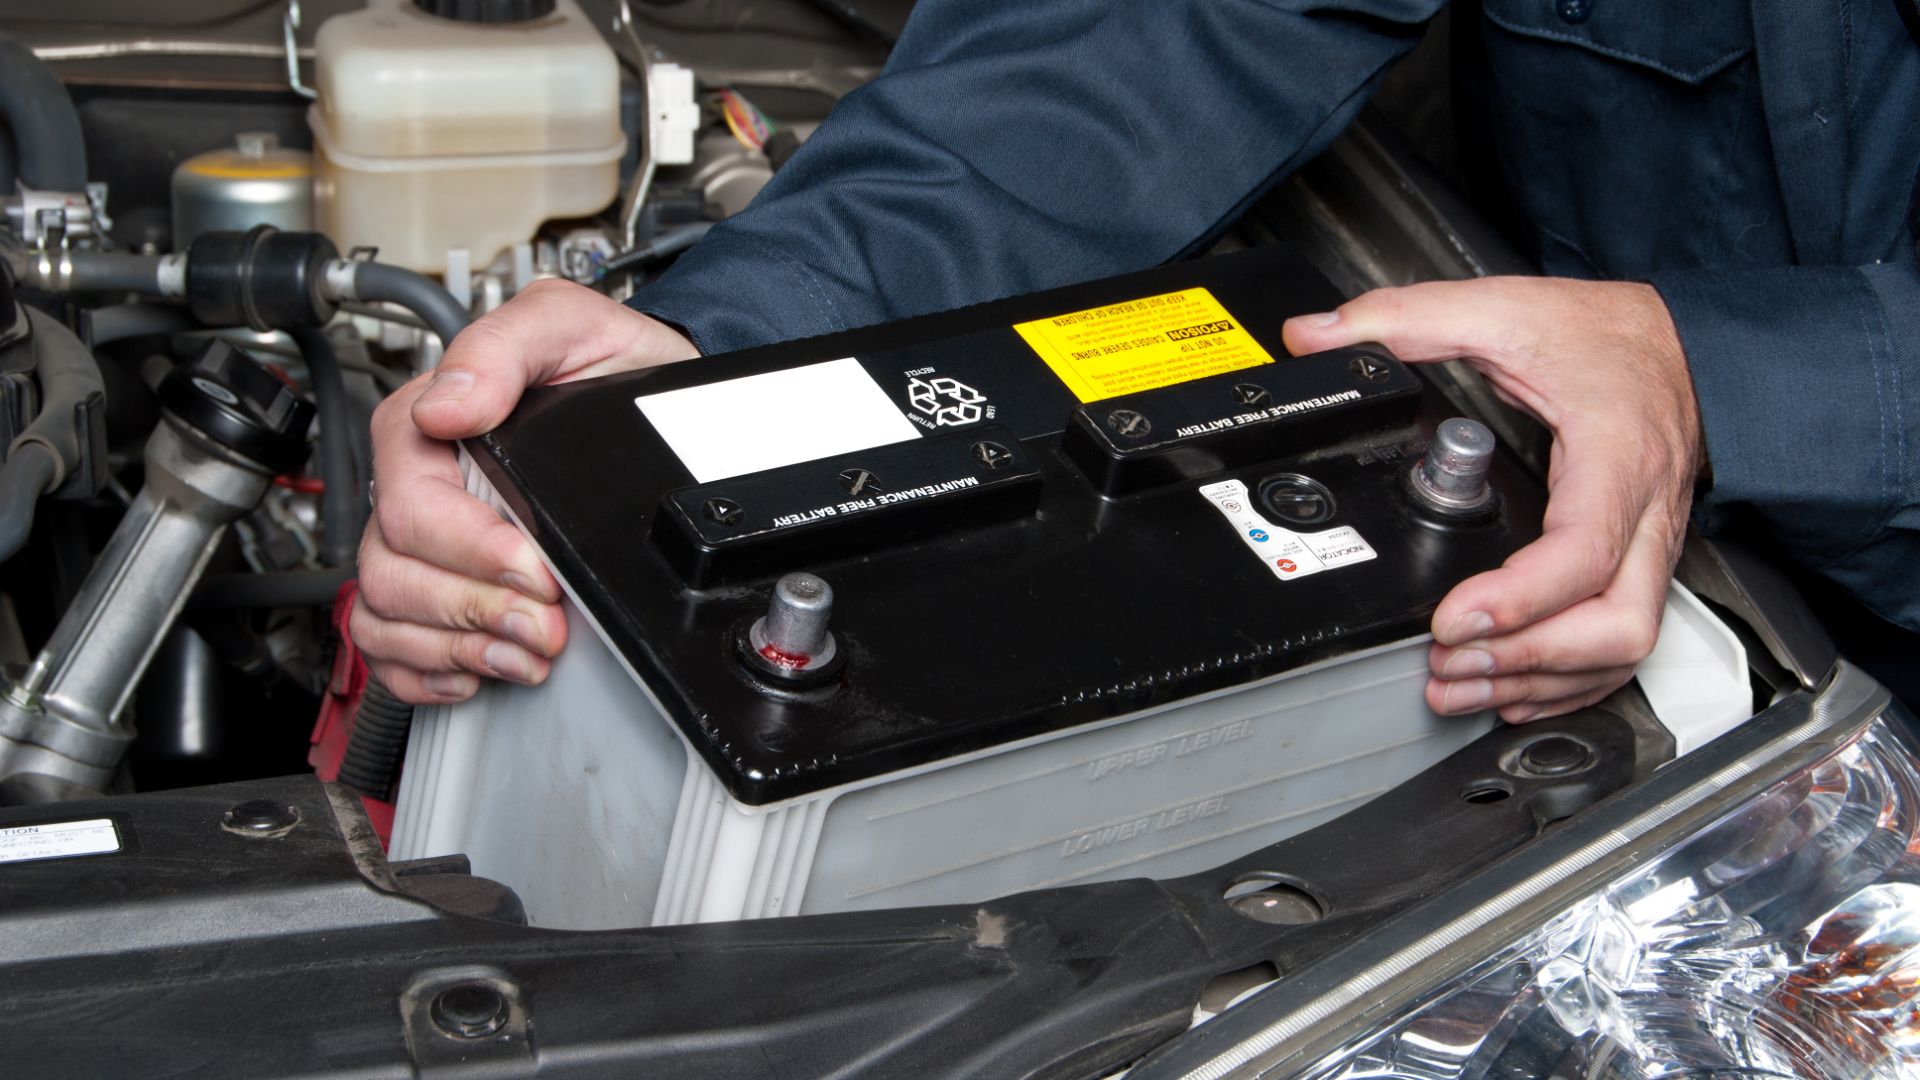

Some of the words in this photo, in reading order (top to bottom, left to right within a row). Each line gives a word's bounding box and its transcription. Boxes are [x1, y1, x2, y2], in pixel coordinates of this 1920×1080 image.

[1145, 297, 1166, 307] OUT
[1163, 293, 1187, 303] KEEP
[1105, 303, 1135, 315] REACH
[1132, 301, 1148, 310] OF
[1051, 312, 1095, 327] CHILDREN
[1092, 309, 1108, 318] OF
[1167, 322, 1220, 340] POISON
[1099, 341, 1134, 354] SEVERE
[1129, 334, 1167, 348] CAUSES
[1193, 339, 1214, 349] NOT
[1210, 336, 1227, 345] DO
[1069, 347, 1102, 361] BURNS
[1176, 343, 1195, 353] TIP
[904, 366, 935, 377] RECYCLE
[1268, 389, 1361, 417] MAINTENANCE
[986, 405, 995, 419] LEAD
[1233, 409, 1268, 425] FREE
[907, 412, 936, 429] RETURN
[1175, 418, 1232, 437] BATTERY
[876, 476, 978, 504] MAINTENANCE
[837, 497, 874, 513] FREE
[772, 506, 834, 528] BATTERY
[1319, 545, 1365, 560] INDICATOR
[1088, 744, 1168, 781] UPPER
[1176, 720, 1255, 758] LEVEL
[1059, 819, 1149, 857] LOWER
[1156, 797, 1229, 831] LEVEL
